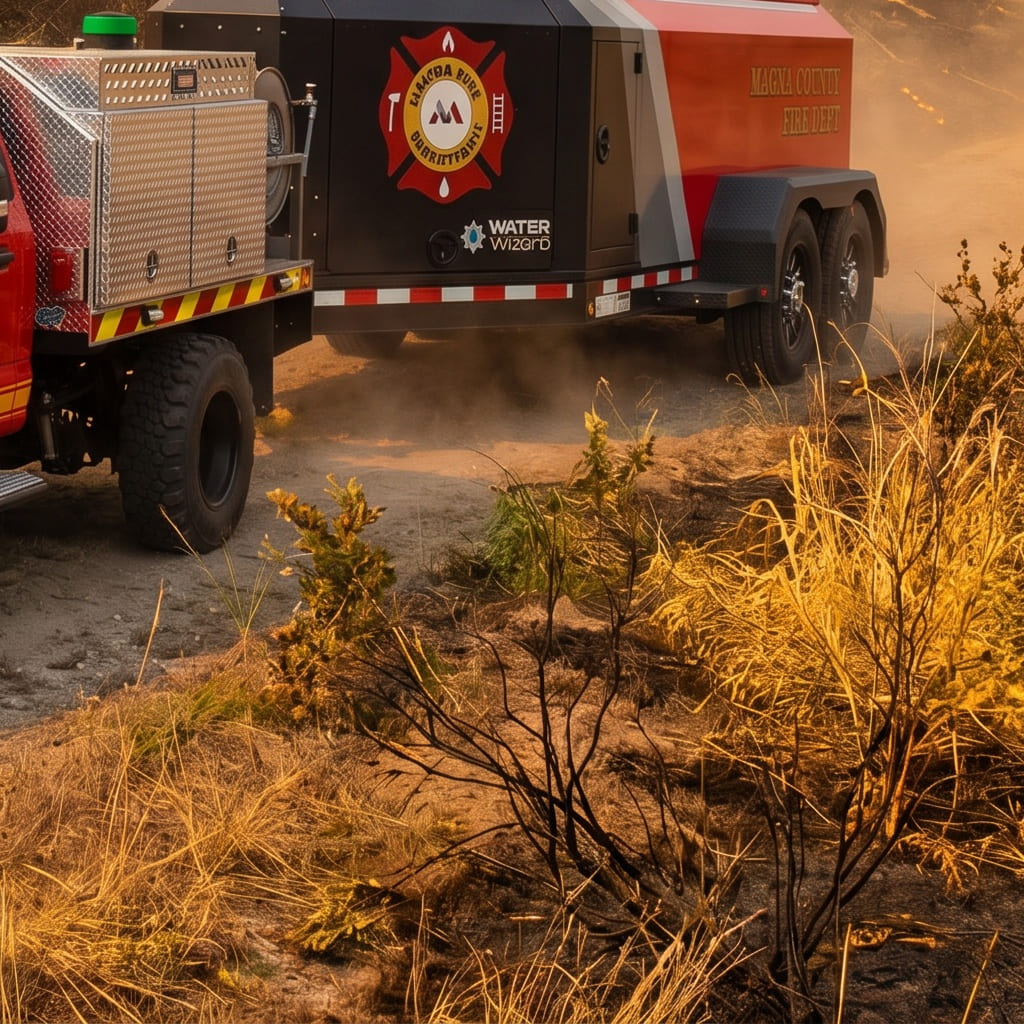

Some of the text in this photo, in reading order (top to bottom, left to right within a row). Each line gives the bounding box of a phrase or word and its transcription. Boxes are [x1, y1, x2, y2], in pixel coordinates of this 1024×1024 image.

[750, 67, 841, 96] MAGNA COUNTY
[782, 105, 841, 135] FIRE DEPT
[488, 219, 551, 235] WATER
